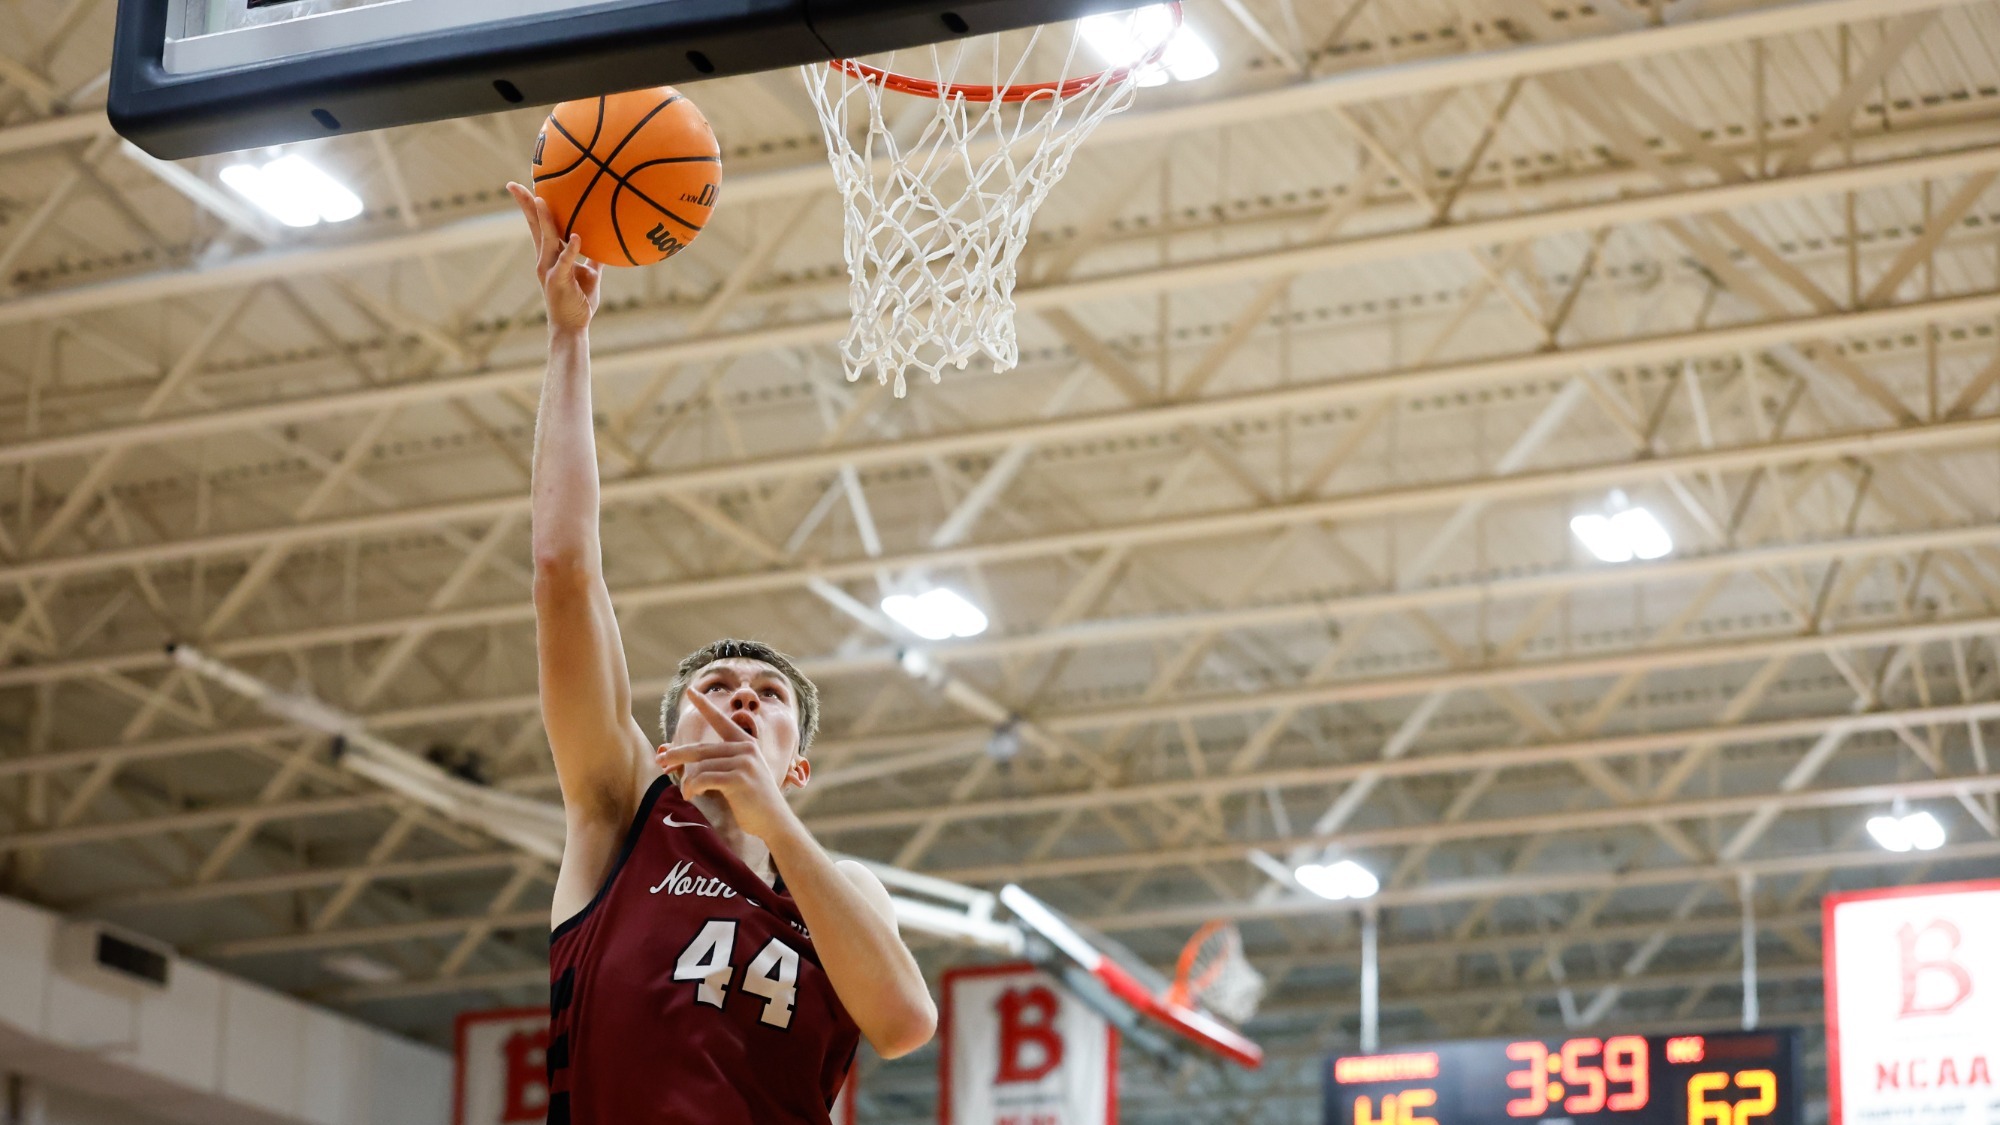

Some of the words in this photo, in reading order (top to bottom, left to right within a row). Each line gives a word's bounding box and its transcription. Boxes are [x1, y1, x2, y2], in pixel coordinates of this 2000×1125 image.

[670, 917, 800, 1032] 44
[1894, 917, 1973, 1021] B
[993, 986, 1064, 1085] B
[1506, 1035, 1649, 1117] 3:59
[1875, 1055, 1991, 1092] NCAA
[1687, 1069, 1776, 1125] 62
